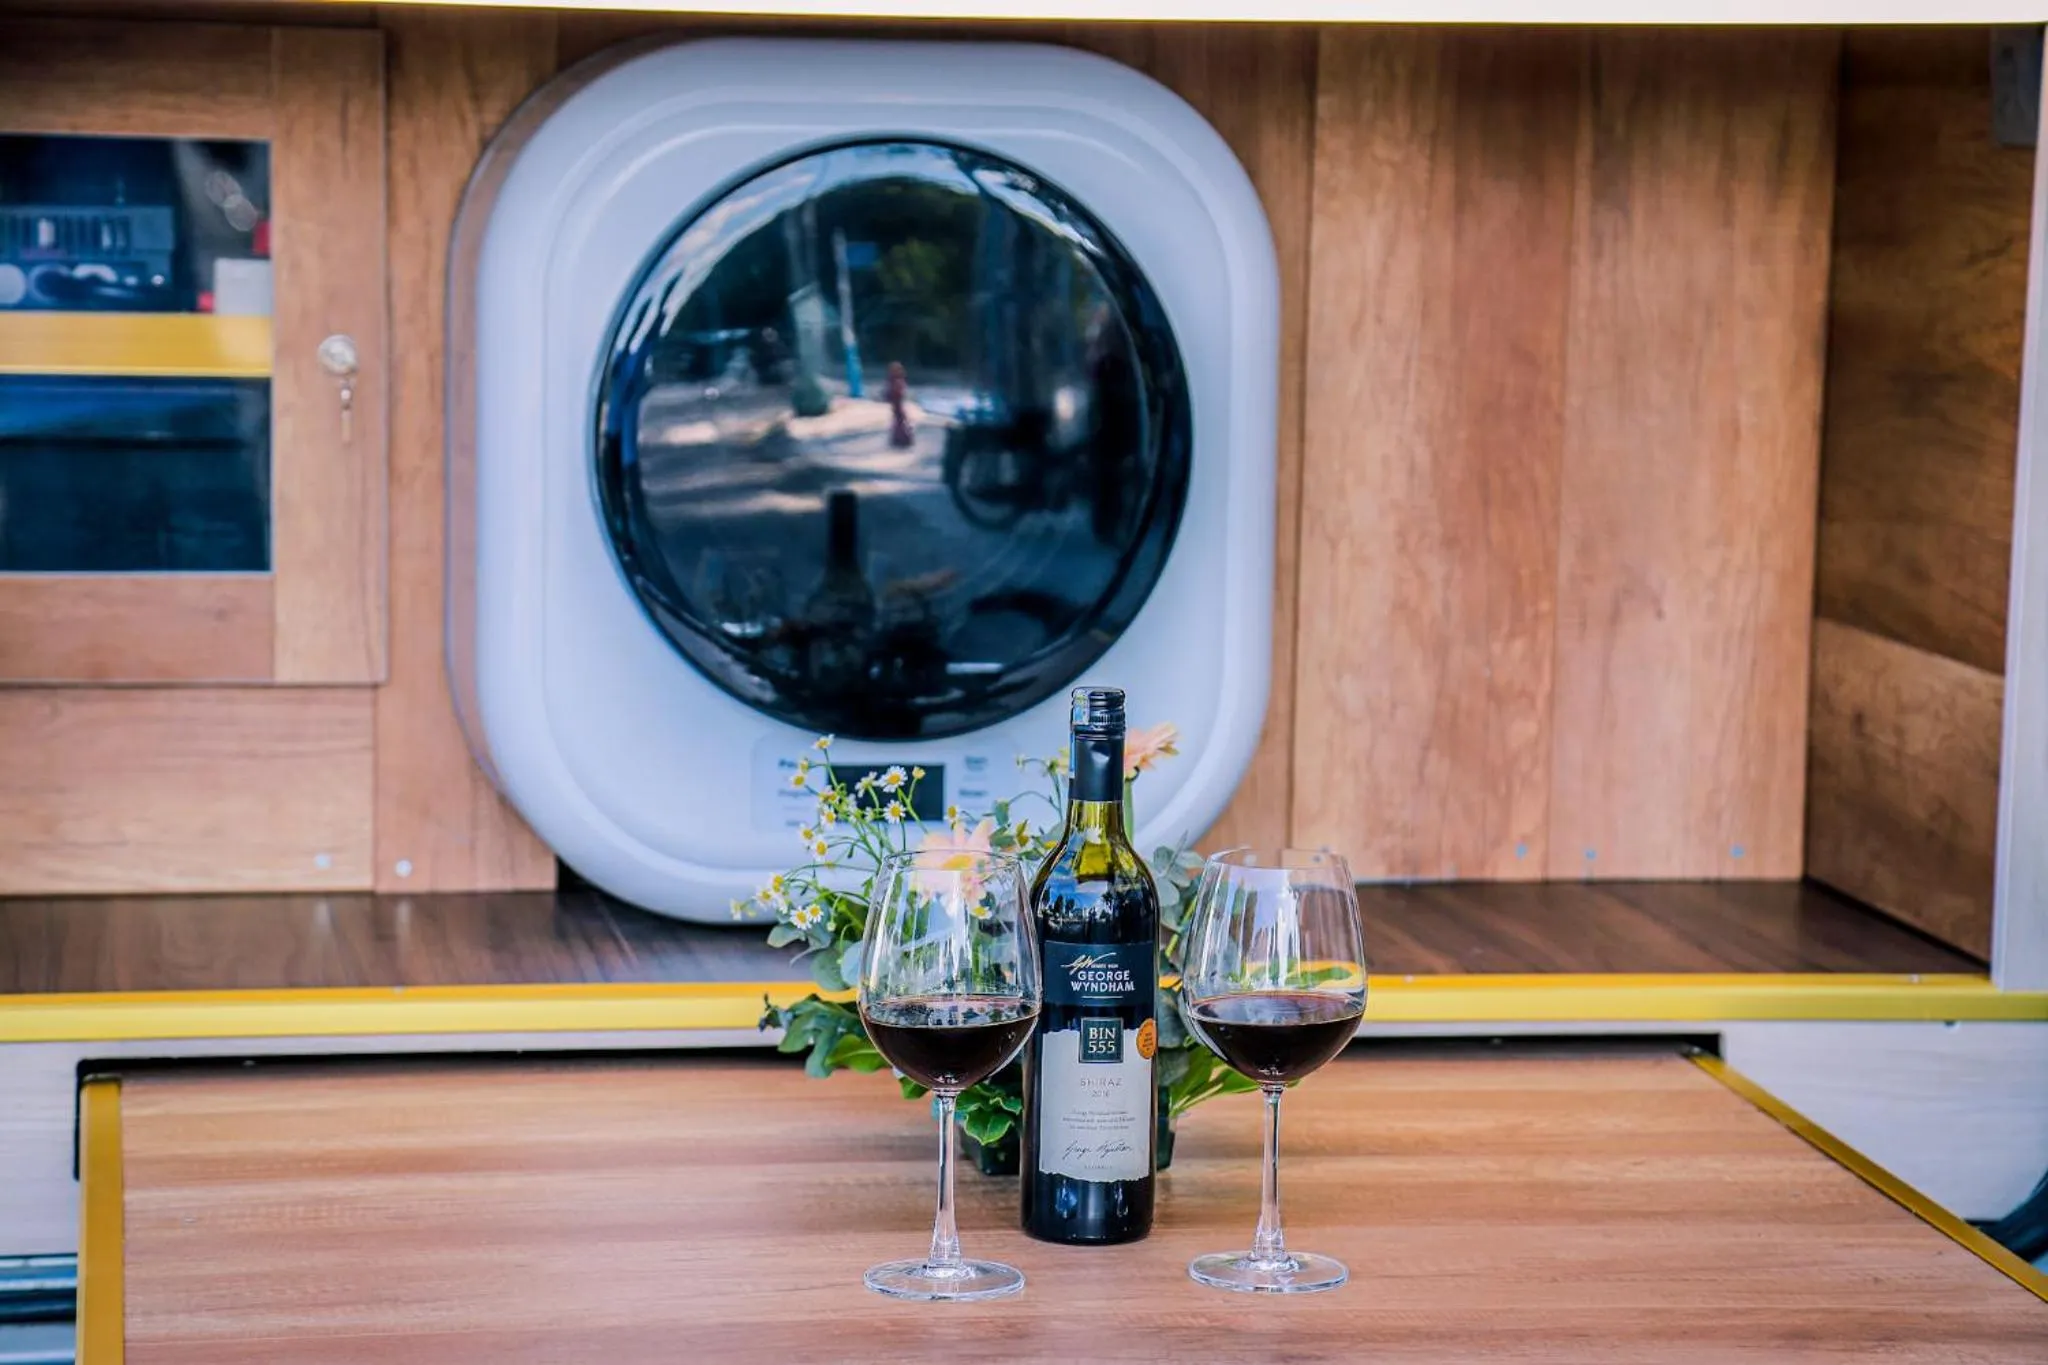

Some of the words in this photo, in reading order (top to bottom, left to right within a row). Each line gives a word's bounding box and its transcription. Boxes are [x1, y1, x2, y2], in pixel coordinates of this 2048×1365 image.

[1077, 970, 1130, 981] GEORGE
[1070, 981, 1135, 992] WYNDHAM
[1089, 1027, 1116, 1040] BIN
[1087, 1040, 1116, 1054] 555
